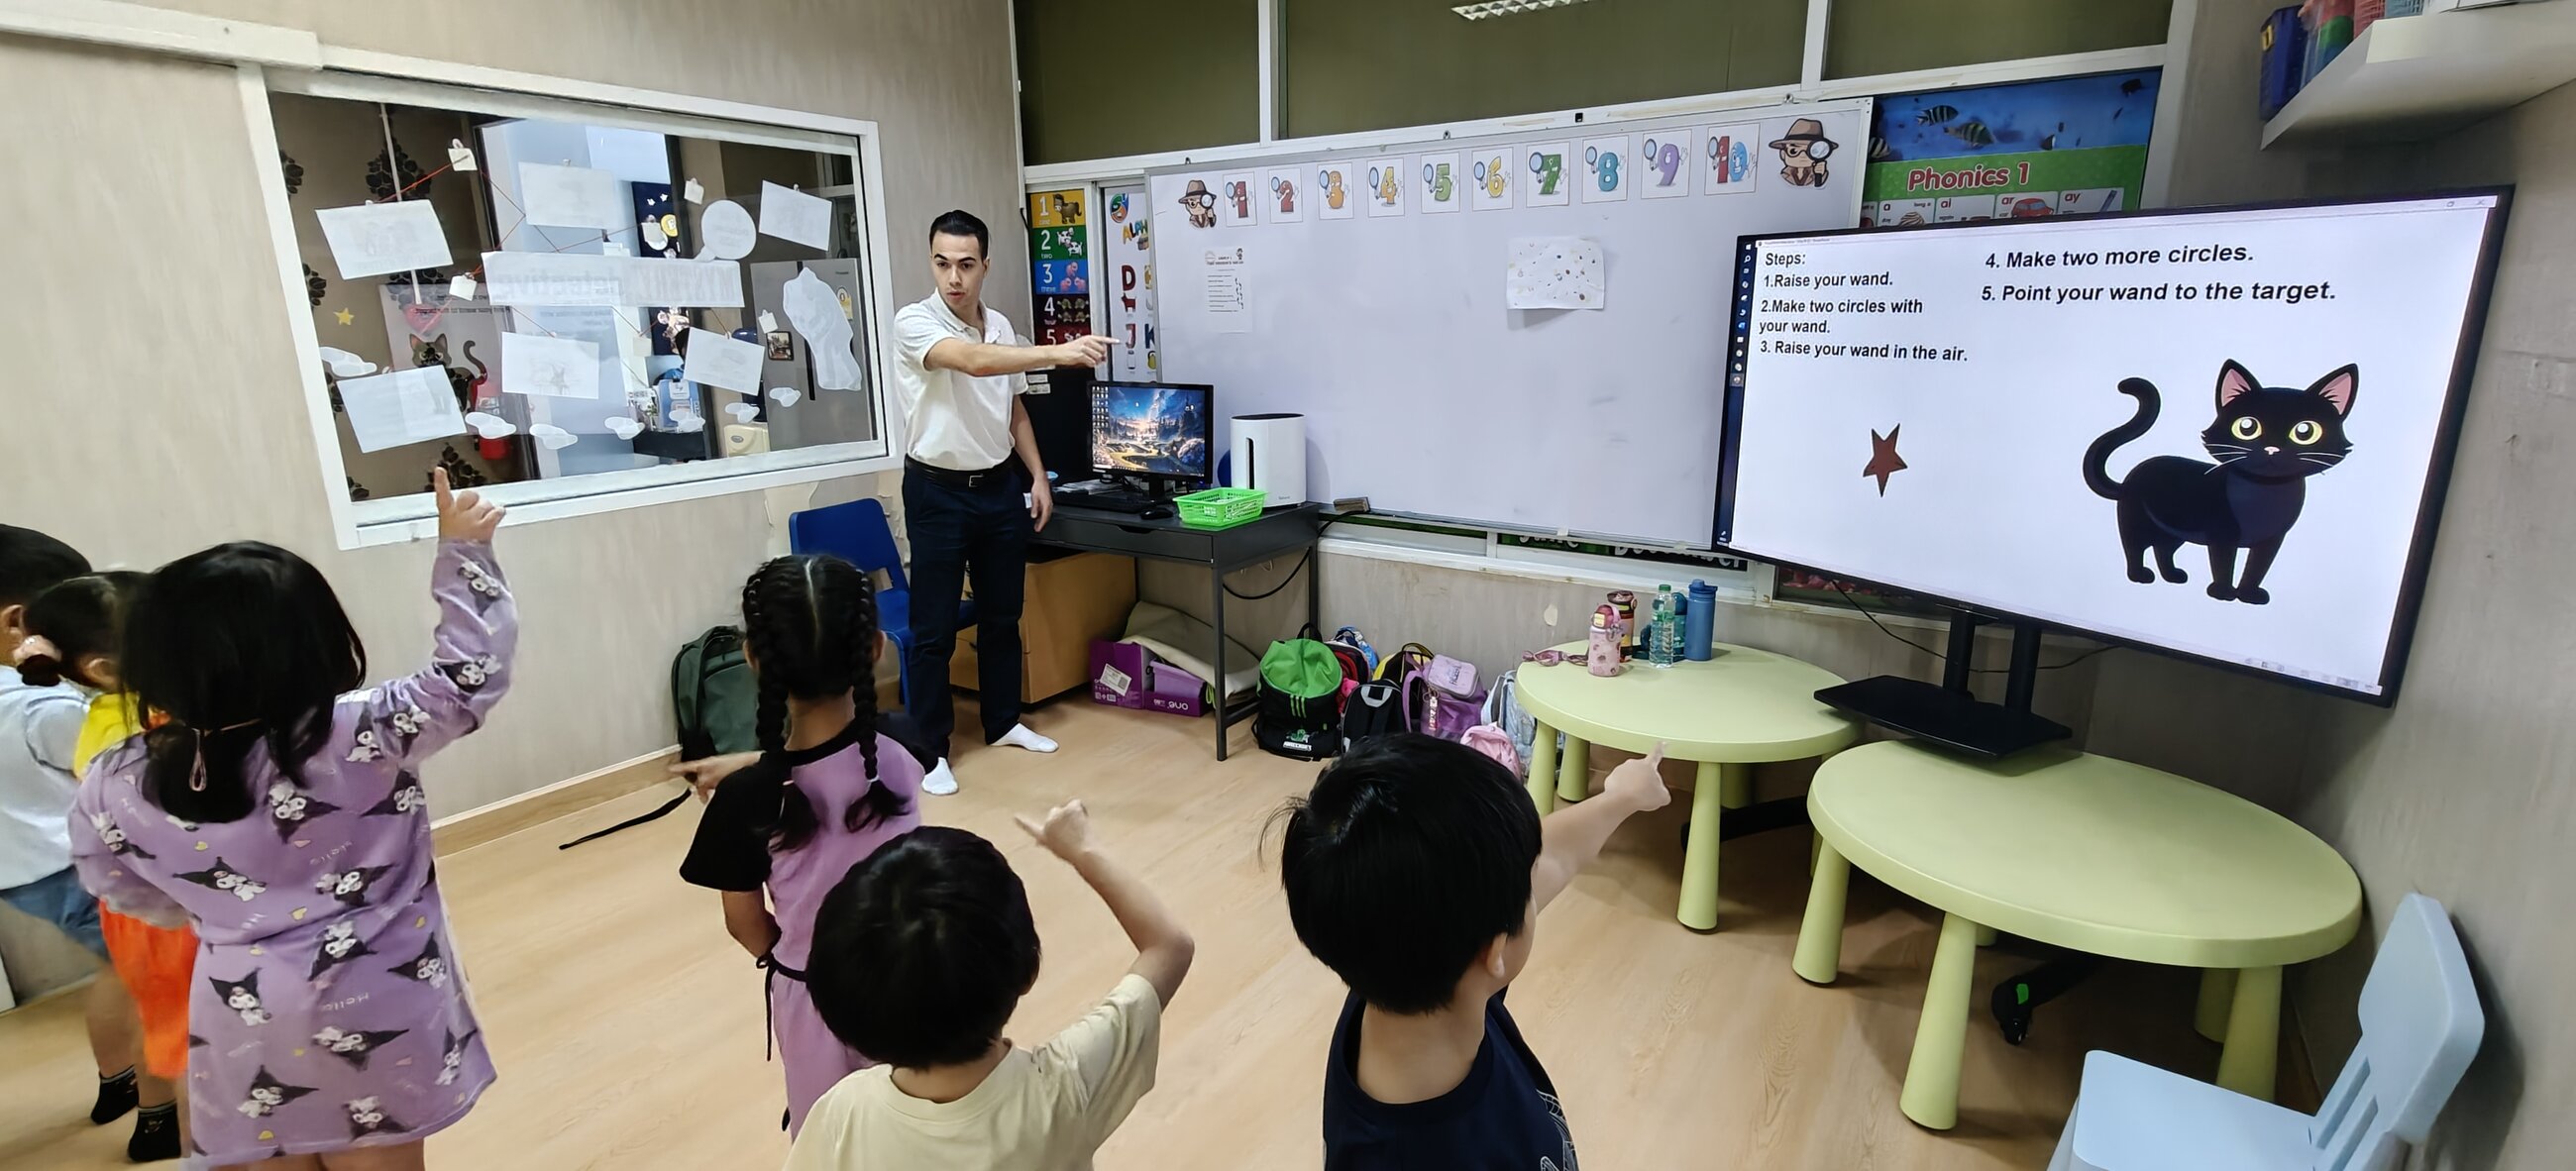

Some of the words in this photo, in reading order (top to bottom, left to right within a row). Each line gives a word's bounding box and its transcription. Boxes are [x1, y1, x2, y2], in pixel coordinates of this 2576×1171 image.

[1435, 163, 1451, 201] 5
[1486, 157, 1504, 198] 6
[1597, 152, 1619, 192] 8
[1907, 164, 2010, 192] Phonics
[2017, 162, 2030, 185] 1
[1039, 196, 1049, 216] 1
[2064, 193, 2081, 203] ay
[1041, 229, 1051, 251] 2
[1765, 252, 1806, 268] Steps:
[1985, 253, 2000, 268] 4.
[2006, 251, 2057, 268] Make
[2062, 251, 2098, 266] two
[2104, 250, 2161, 266] more
[2168, 244, 2254, 264] circles.
[1042, 263, 1053, 284] 3
[1121, 265, 1136, 291] D
[1764, 273, 1811, 287] 1.Raise
[1813, 275, 1847, 290] your
[1849, 270, 1893, 286] wand.
[1981, 285, 1996, 301] 5.
[2001, 284, 2052, 301] Point
[2056, 287, 2104, 305] your
[2109, 282, 2169, 301] wand
[2175, 283, 2198, 300] to
[2205, 281, 2243, 300] the
[2251, 281, 2335, 304] target.
[1044, 296, 1055, 316] 4
[1761, 299, 1806, 313] 2.Make
[1809, 300, 1834, 313] two
[1838, 298, 1886, 313] circles
[1890, 298, 1923, 314] with
[1046, 329, 1057, 345] 5
[1125, 323, 1136, 349] J
[1759, 321, 1789, 335] your
[1791, 319, 1831, 334] wand.
[1760, 340, 1771, 354] 3.
[1774, 340, 1811, 355] Raise
[1814, 344, 1847, 359] your
[1850, 344, 1889, 359] wand
[1893, 344, 1908, 360] in
[1912, 345, 1938, 361] the
[1942, 346, 1968, 362] air.
